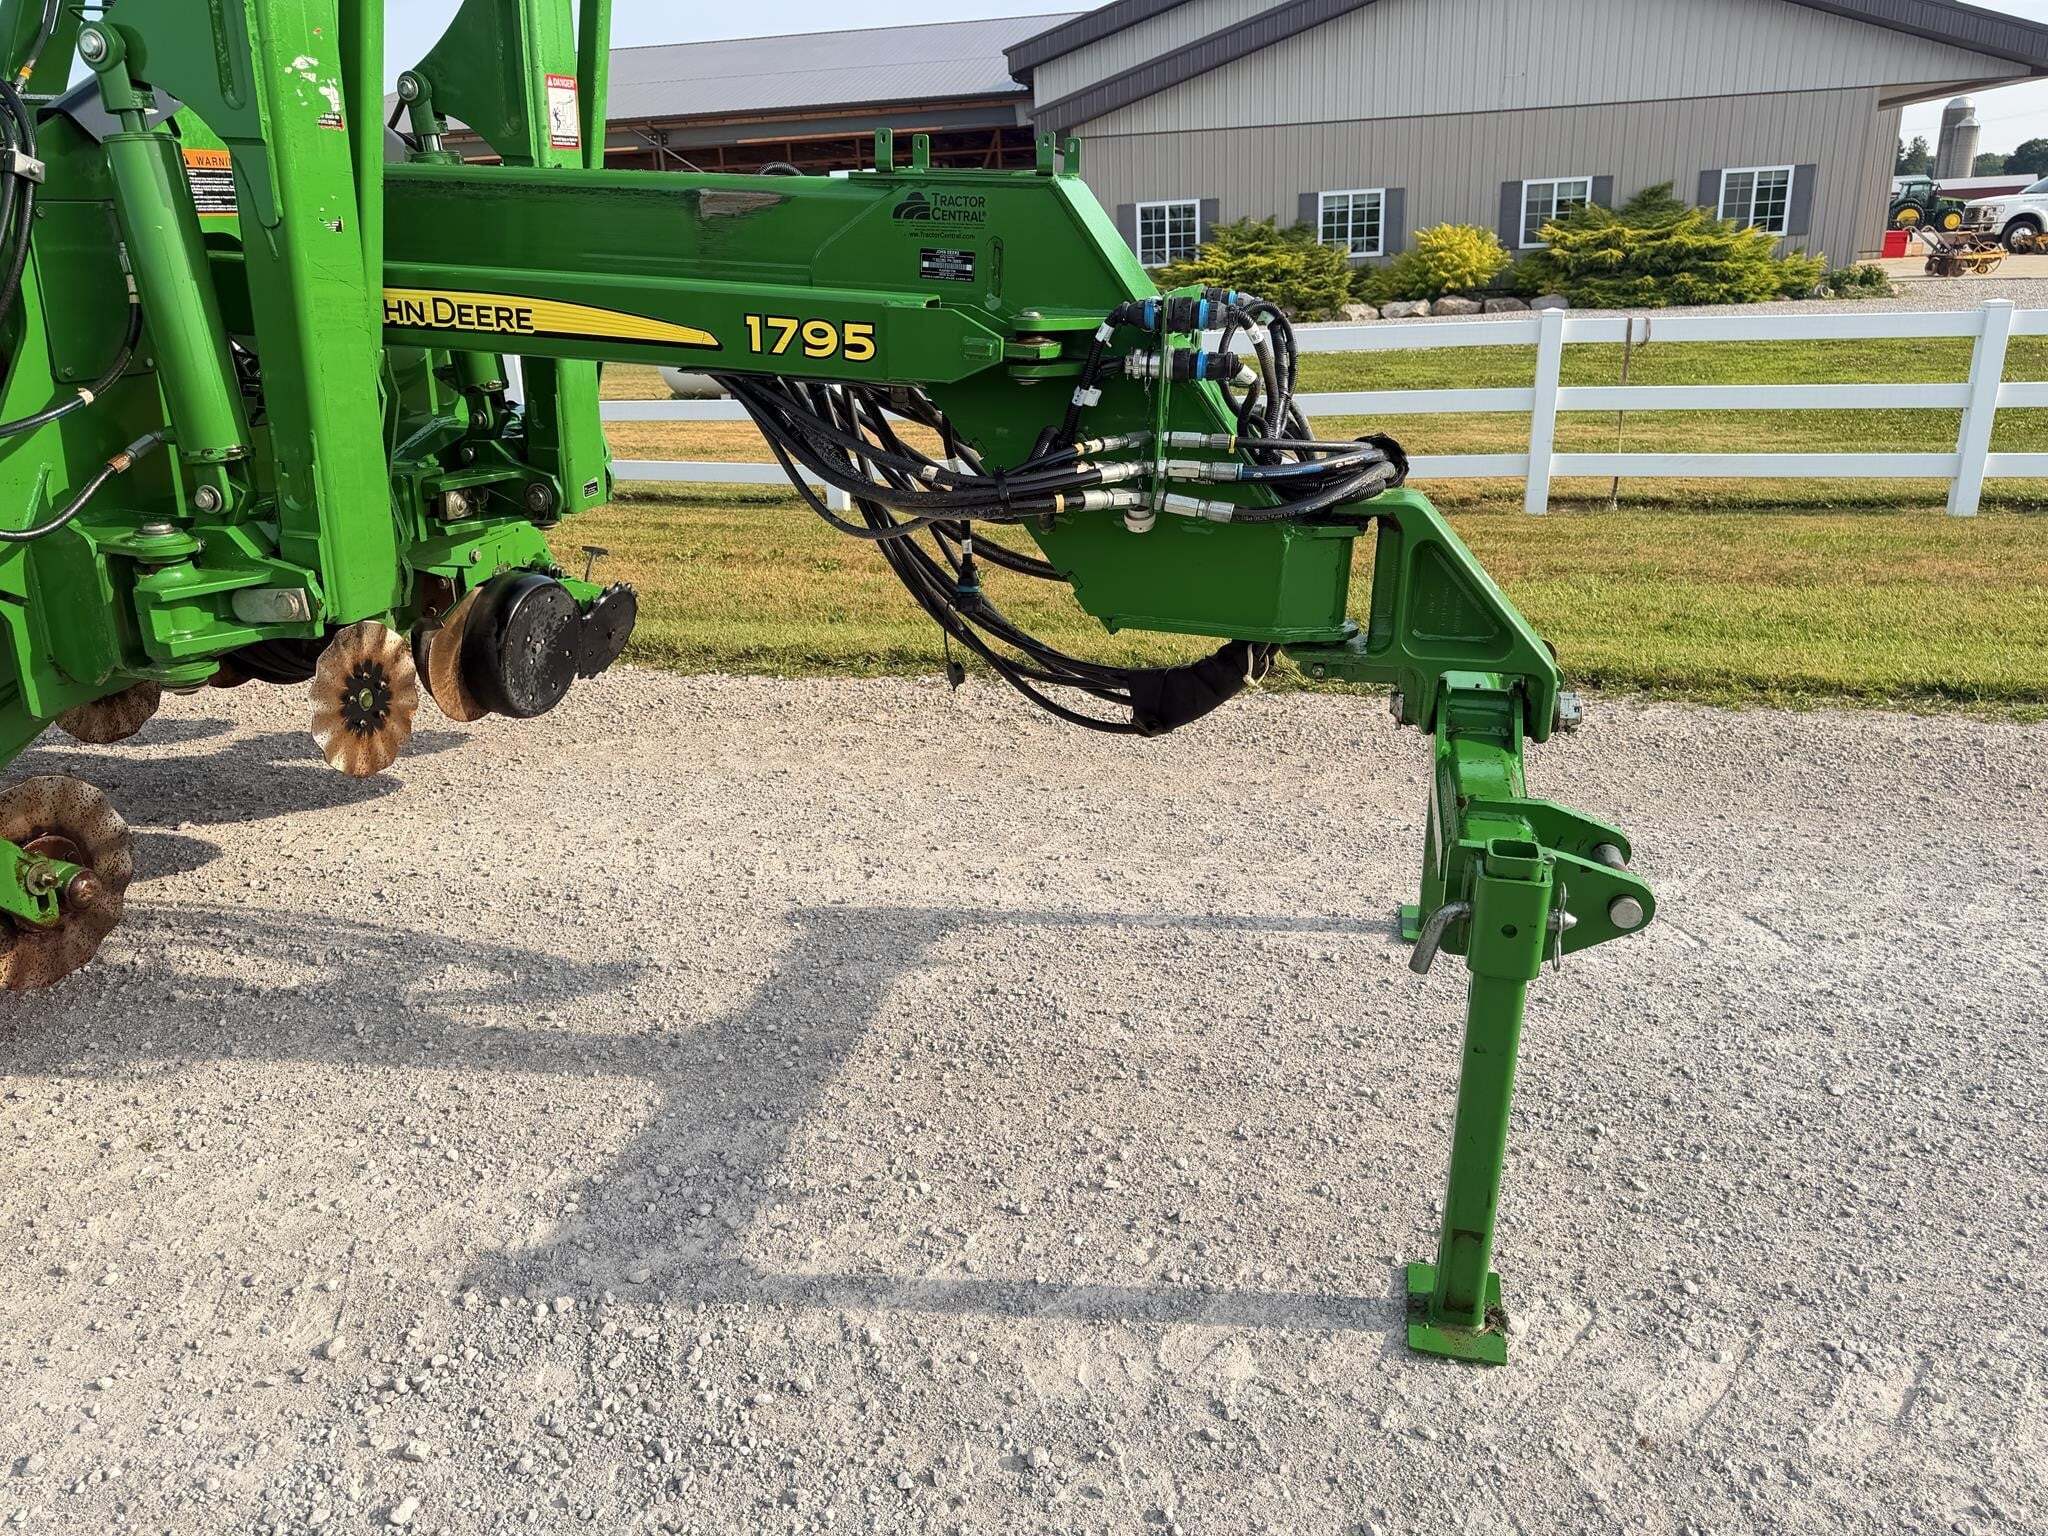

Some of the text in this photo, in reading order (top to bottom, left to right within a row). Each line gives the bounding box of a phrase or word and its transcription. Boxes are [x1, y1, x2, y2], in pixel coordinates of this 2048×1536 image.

[196, 155, 231, 167] WARNI
[931, 192, 986, 208] TRACTOR
[432, 297, 534, 331] DEERE
[745, 314, 876, 361] 1795
